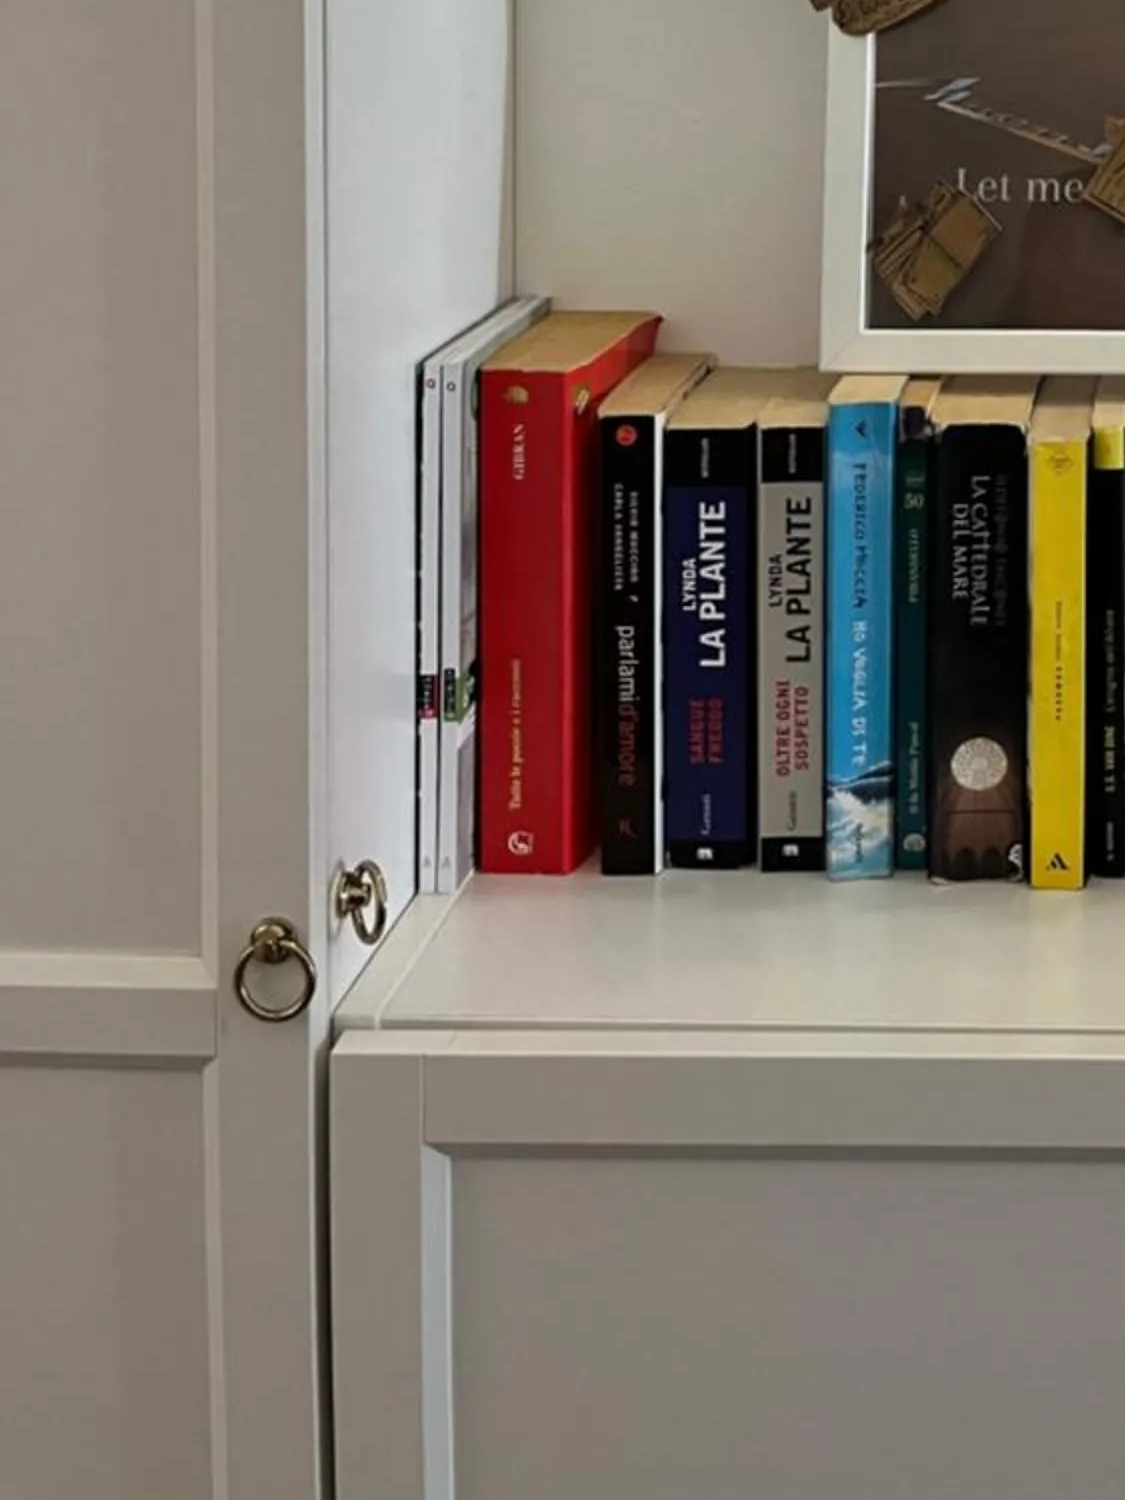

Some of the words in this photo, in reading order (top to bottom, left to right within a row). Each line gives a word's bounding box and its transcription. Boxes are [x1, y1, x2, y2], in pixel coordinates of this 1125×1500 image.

[1026, 176, 1084, 204] me
[512, 424, 525, 480] GIBRAN
[970, 475, 991, 499] LA
[952, 503, 971, 540] DEL
[700, 501, 727, 620] PLANTE
[768, 553, 783, 608] LYNDA
[786, 497, 812, 616] PLANTE
[952, 545, 970, 600] MARE
[970, 502, 991, 626] CATTEDRALE
[683, 558, 698, 612] LYNDA
[700, 629, 727, 668] LA
[786, 624, 812, 663] LA
[775, 681, 790, 721] OGNI
[793, 686, 810, 771] SOSPETTO
[690, 699, 705, 764] SANGUE
[707, 699, 723, 764] FREDDO
[775, 727, 790, 777] OLTRE
